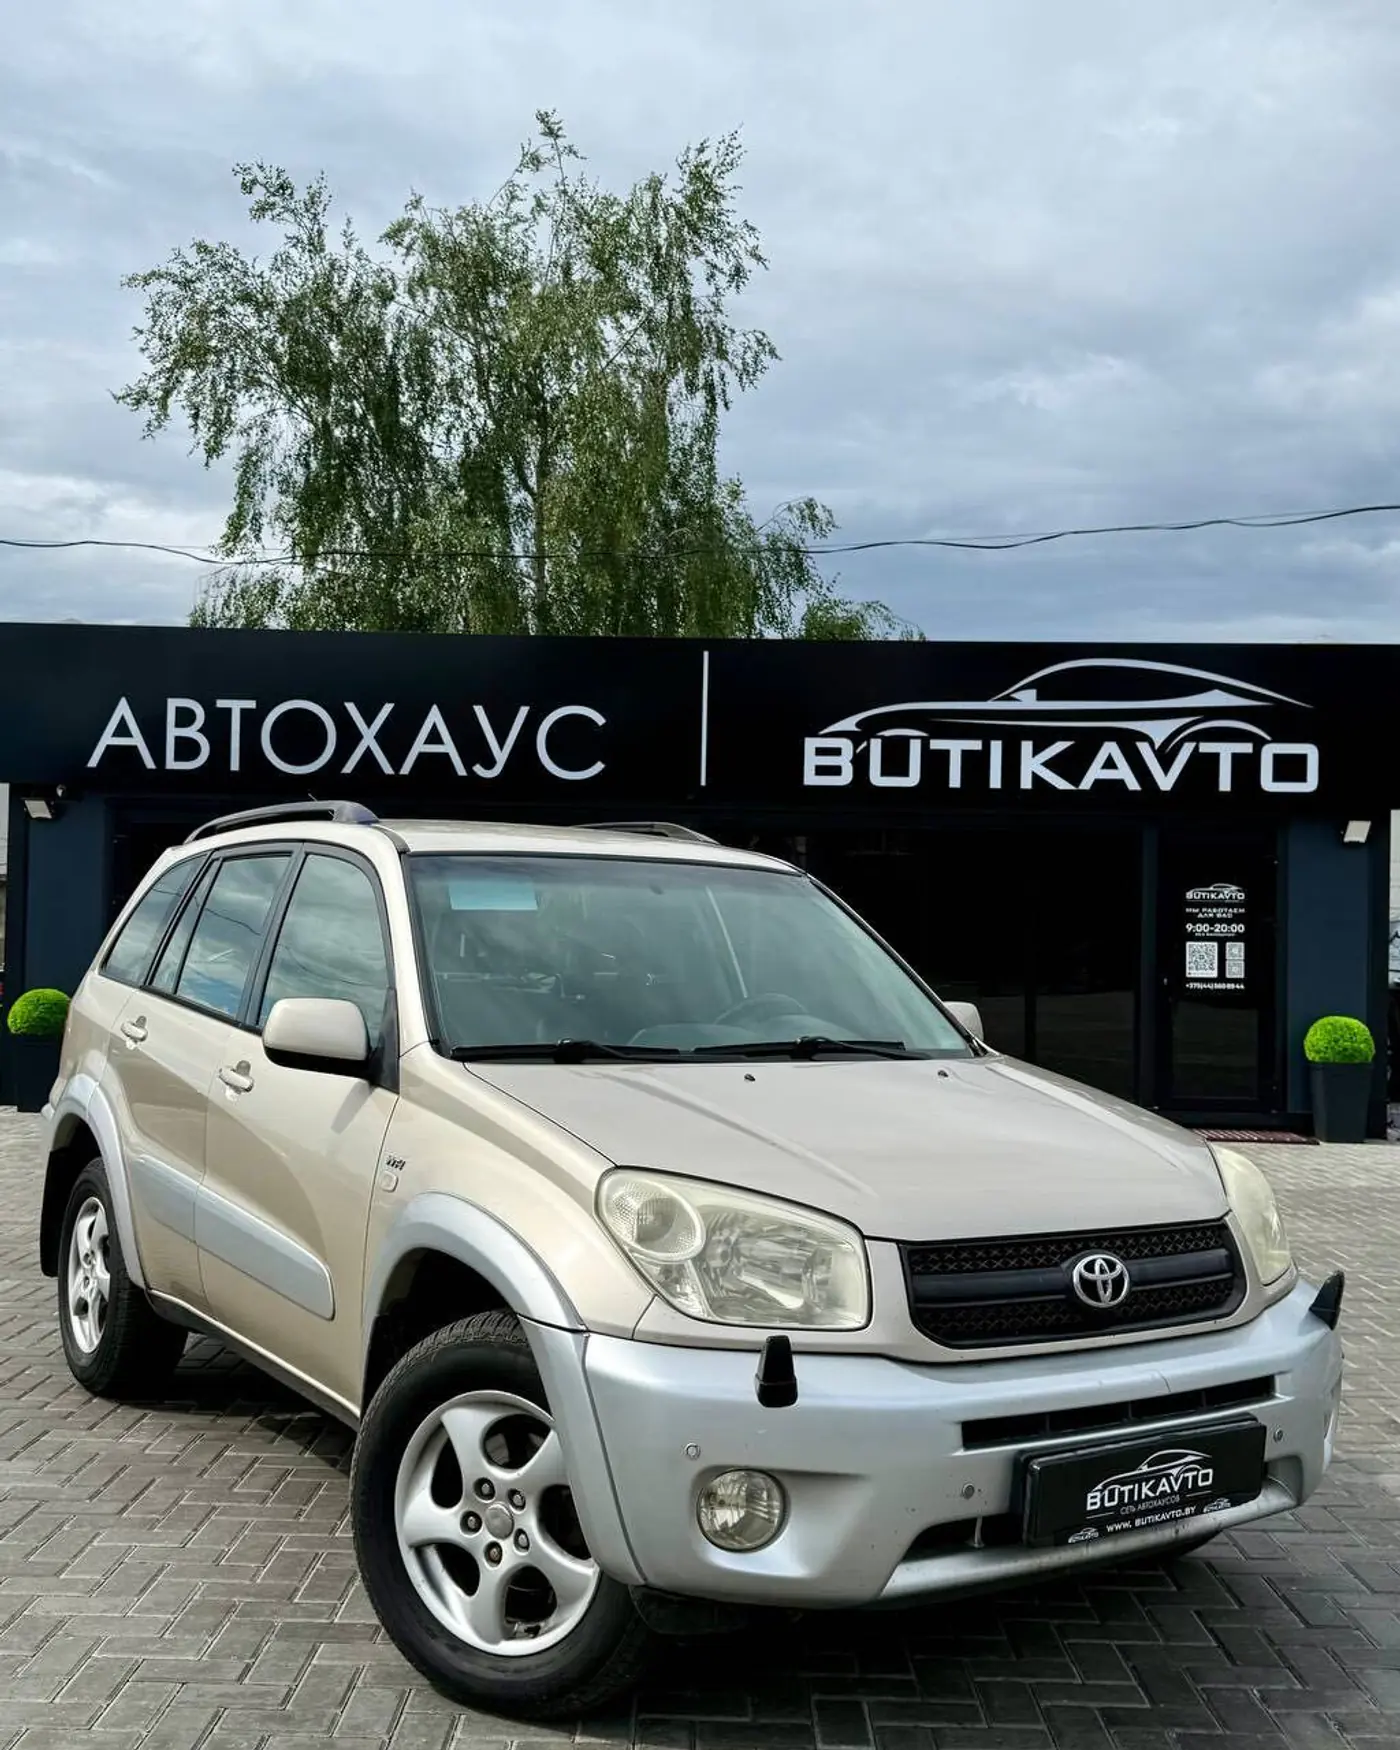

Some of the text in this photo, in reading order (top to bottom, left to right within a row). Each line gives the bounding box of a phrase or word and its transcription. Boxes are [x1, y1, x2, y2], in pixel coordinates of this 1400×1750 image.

[87, 696, 606, 780] АВТОХАУС
[803, 736, 1319, 793] BUTIKAVTO
[1185, 922, 1246, 933] 9:00-20:00
[1085, 1467, 1214, 1511] BUTIKAVTO
